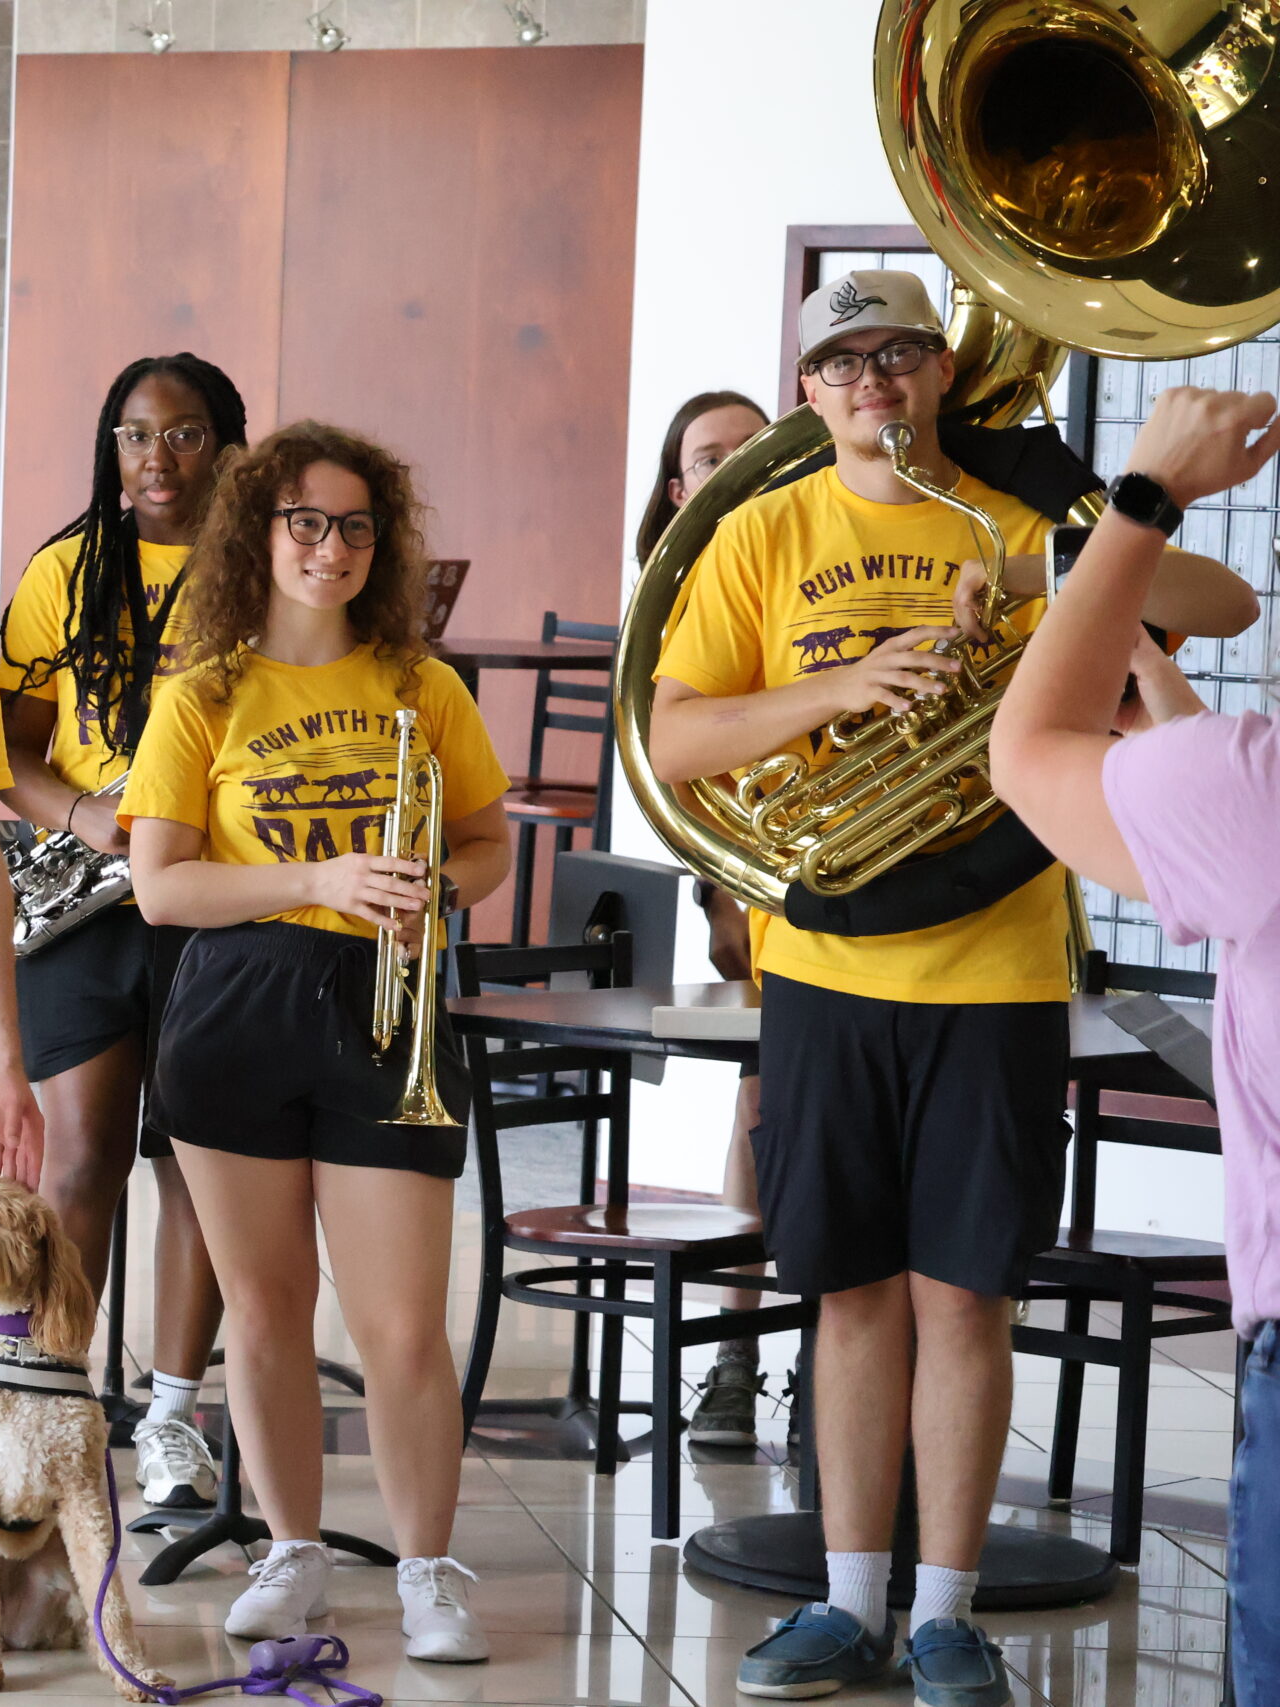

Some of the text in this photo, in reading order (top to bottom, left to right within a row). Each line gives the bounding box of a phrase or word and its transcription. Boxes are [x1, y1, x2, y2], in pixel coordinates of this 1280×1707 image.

[798, 561, 856, 606] RUN
[861, 554, 935, 582] WITH
[247, 722, 300, 760] RUN
[300, 709, 368, 739] WITH
